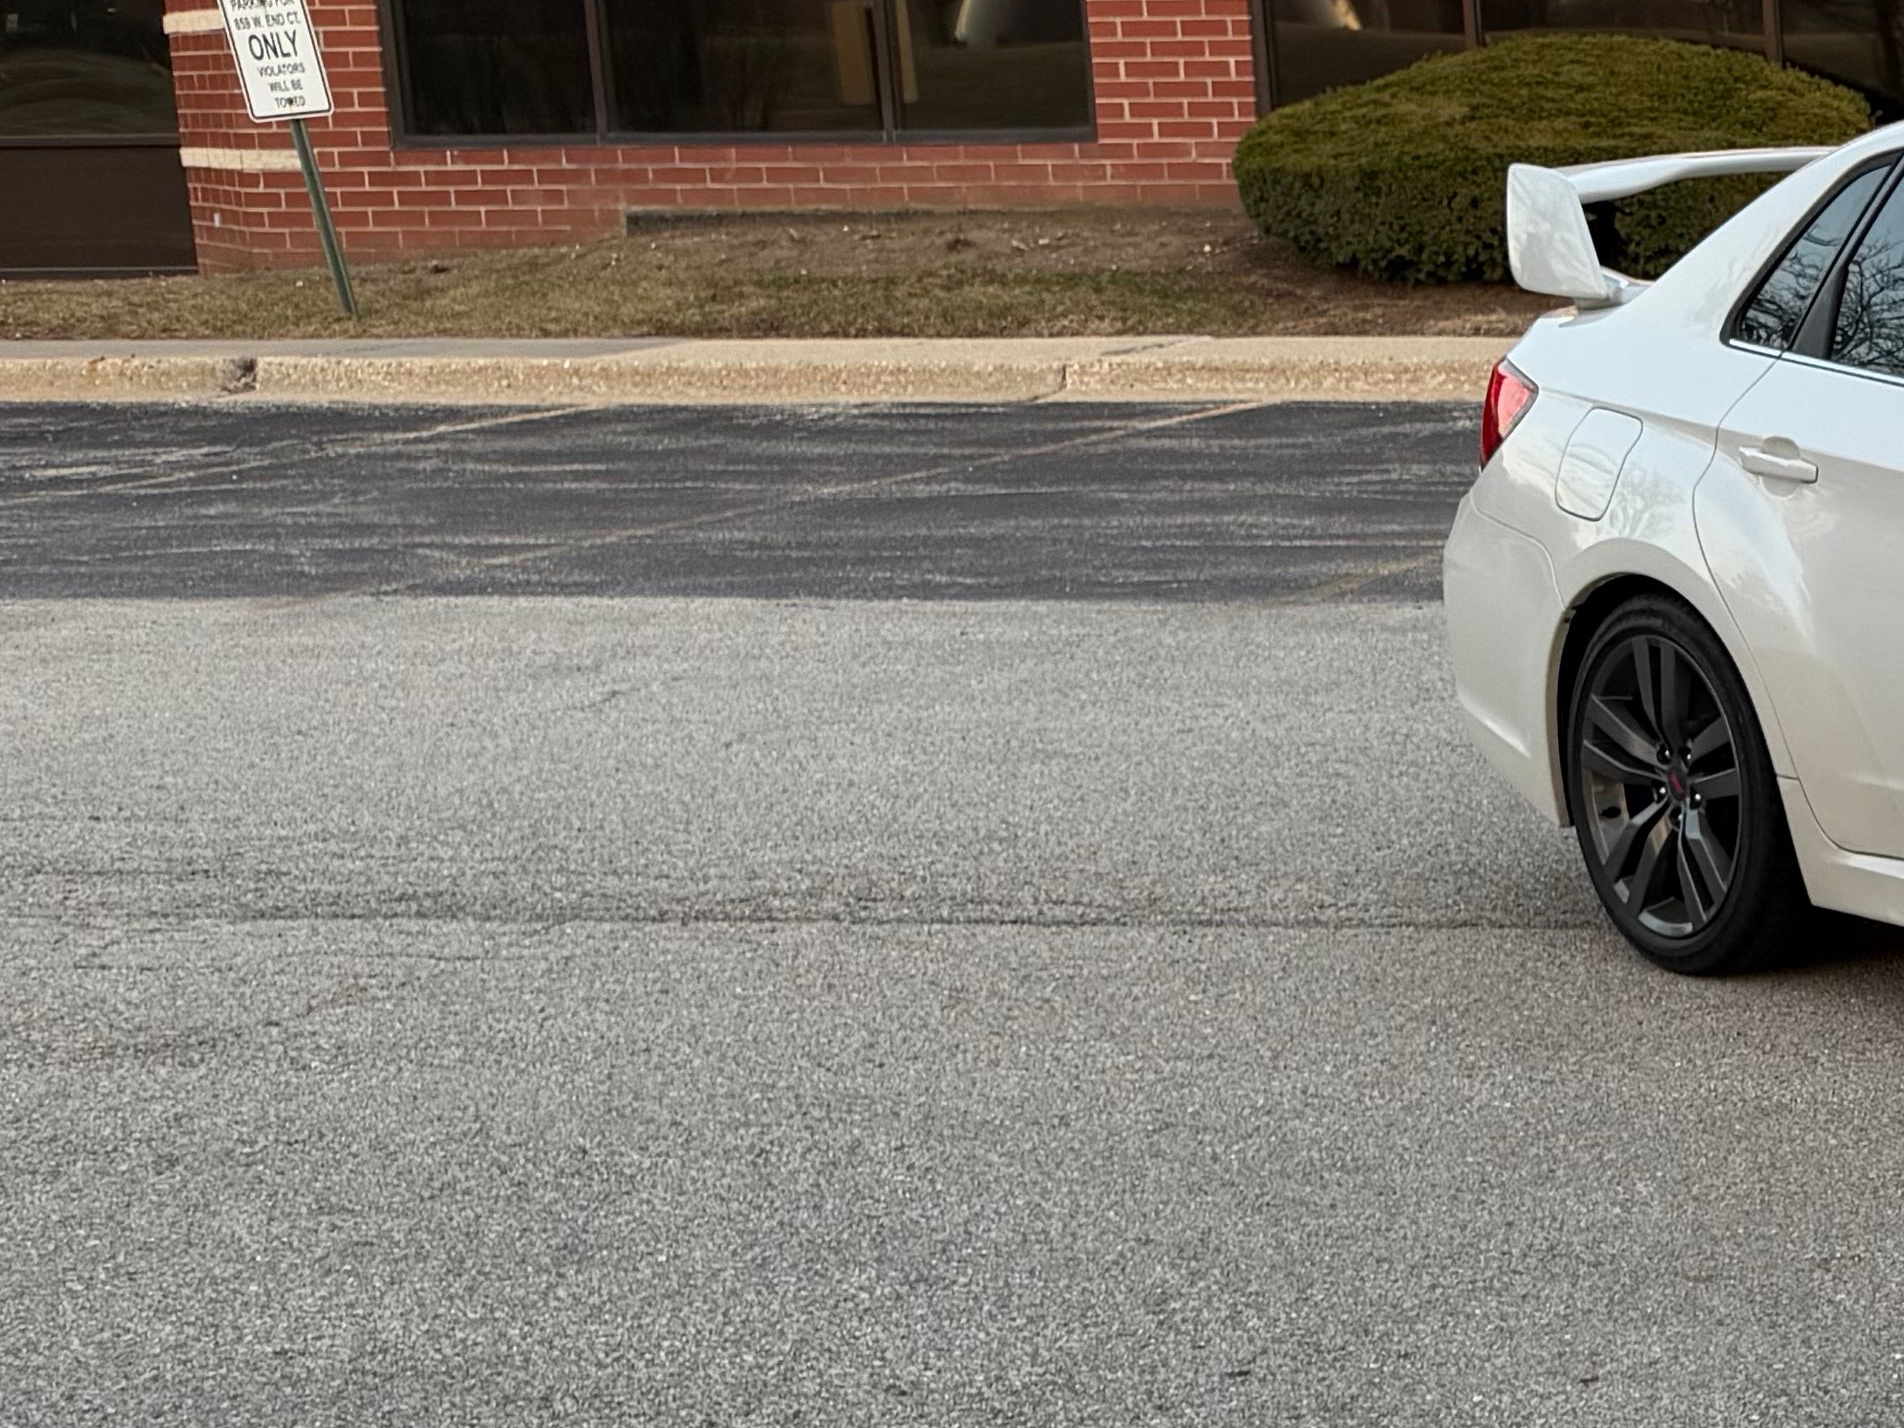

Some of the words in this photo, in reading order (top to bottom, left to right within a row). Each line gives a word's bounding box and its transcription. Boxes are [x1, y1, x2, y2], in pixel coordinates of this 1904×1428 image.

[265, 12, 285, 28] END
[248, 30, 298, 61] ONLY
[257, 62, 305, 77] VIOLATORS
[268, 80, 290, 92] WILL
[291, 79, 304, 91] BE
